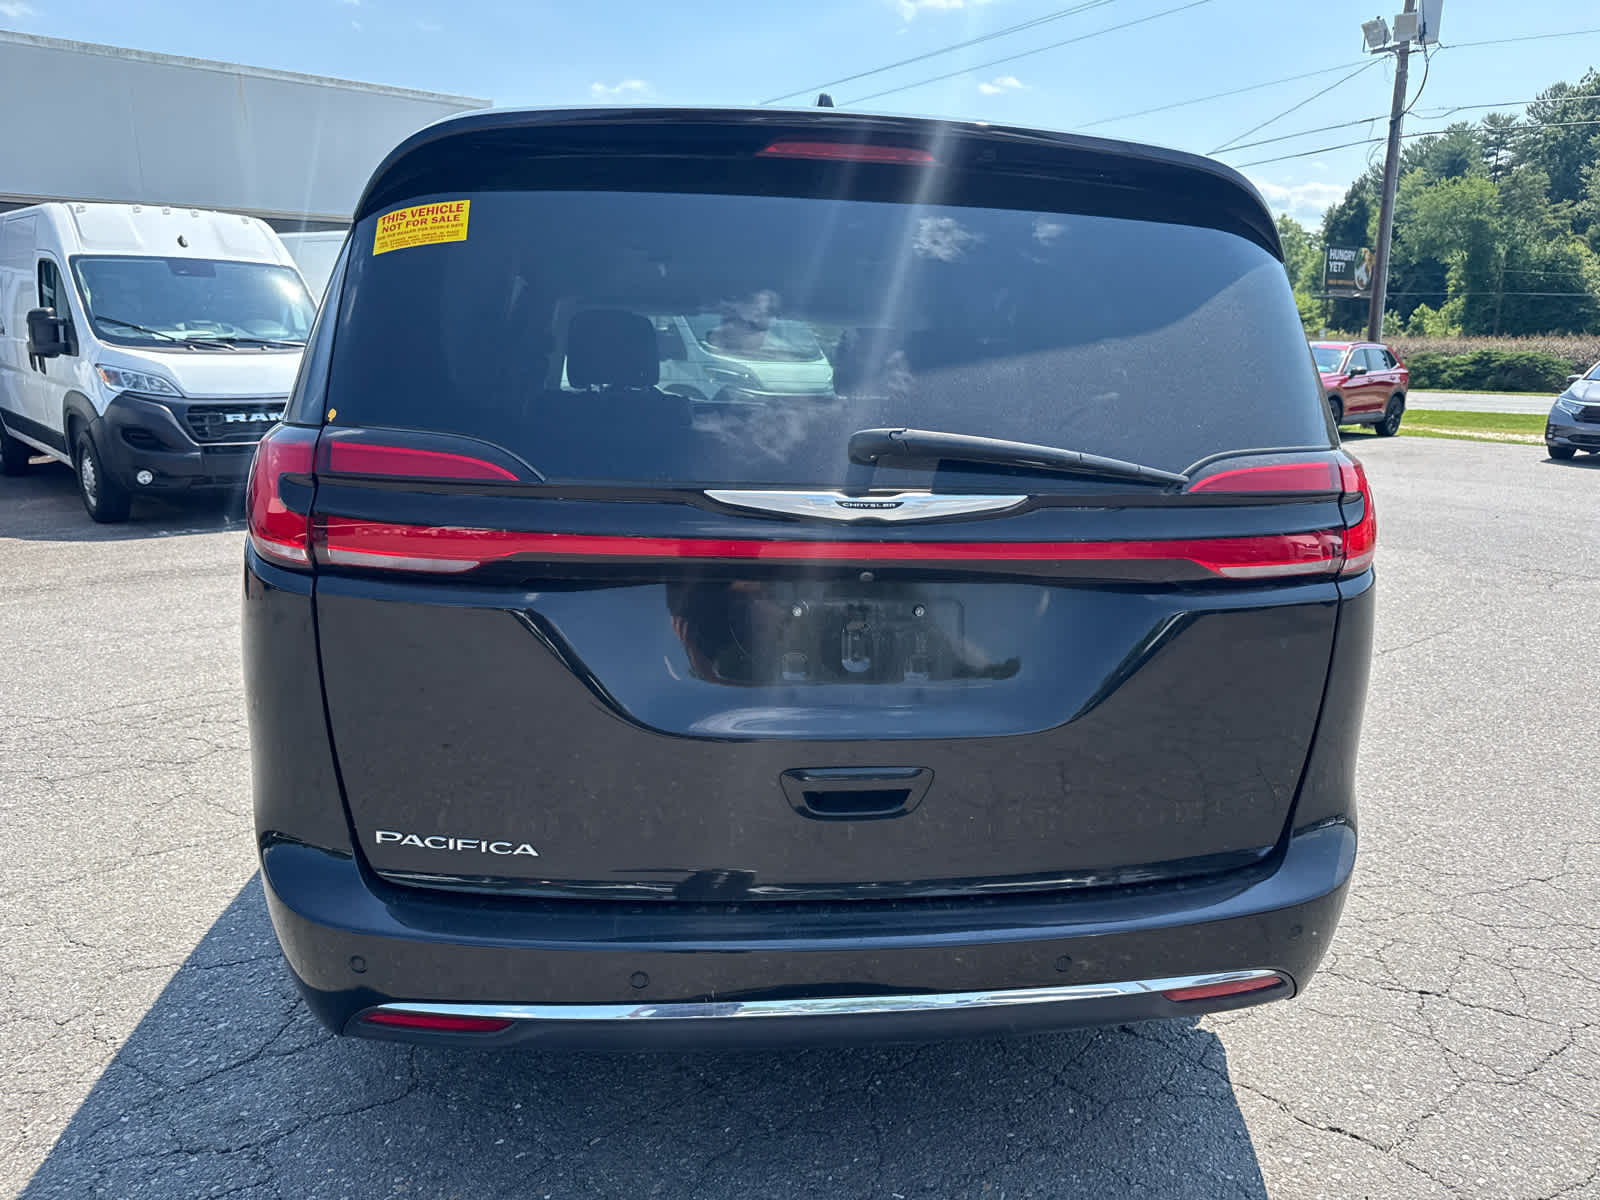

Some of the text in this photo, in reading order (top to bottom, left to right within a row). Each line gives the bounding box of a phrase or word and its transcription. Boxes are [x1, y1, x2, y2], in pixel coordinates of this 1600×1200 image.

[381, 202, 465, 226] THIS VEHICLE
[382, 222, 403, 233] NOT
[405, 218, 428, 228] FOR
[431, 214, 461, 224] SALE
[1329, 247, 1356, 261] HUNGRY
[1328, 261, 1346, 272] YET?
[375, 830, 539, 857] PACIFICA
